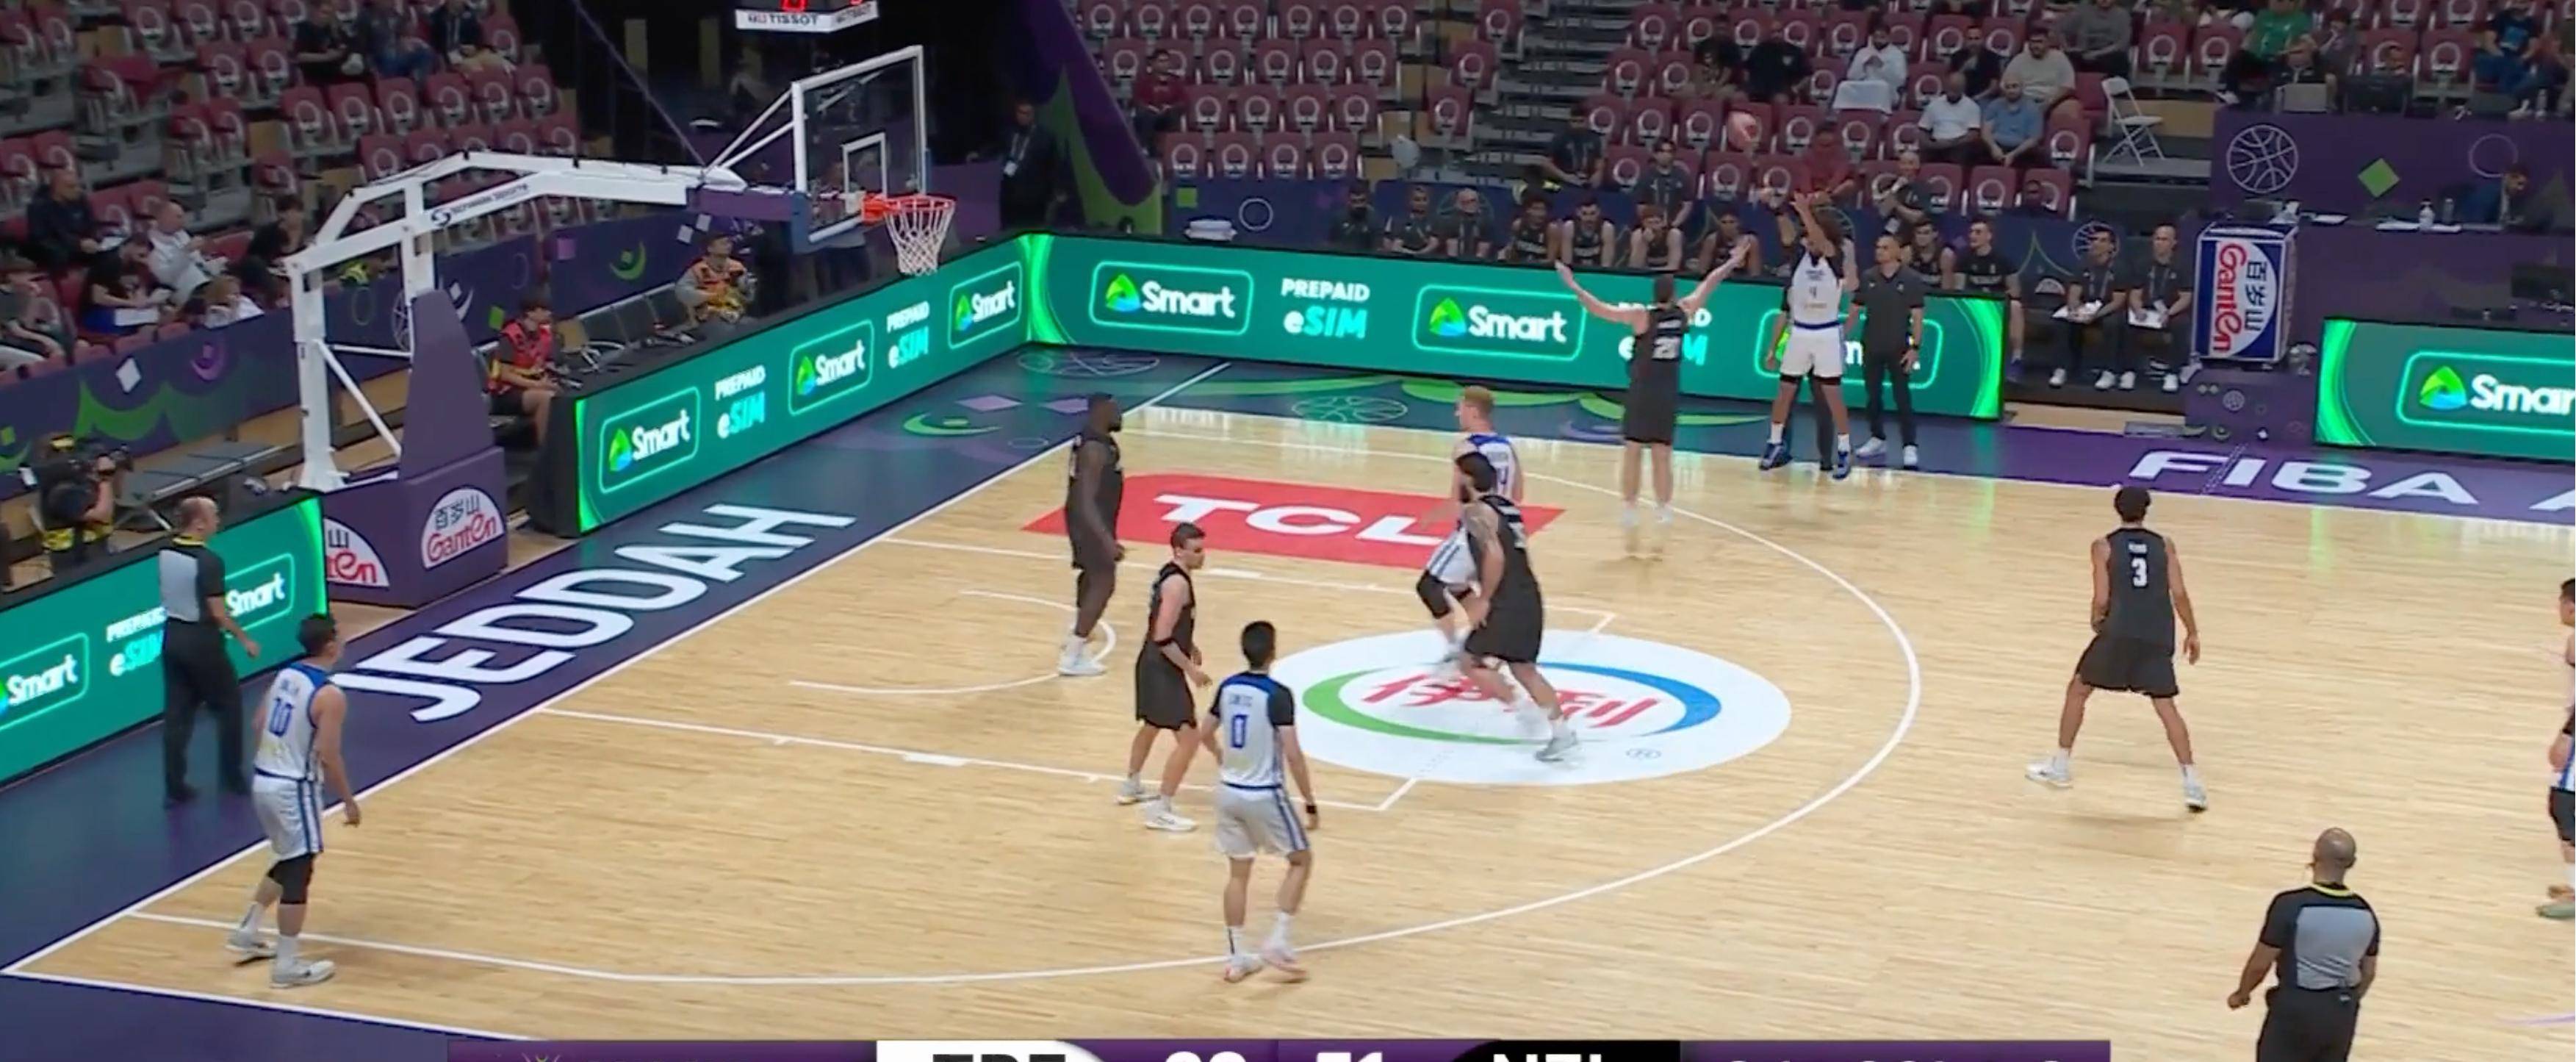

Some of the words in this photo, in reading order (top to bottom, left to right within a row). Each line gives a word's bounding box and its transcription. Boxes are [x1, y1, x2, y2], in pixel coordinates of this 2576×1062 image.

[973, 280, 1015, 322] Smart
[1142, 281, 1235, 317] Smart
[1281, 278, 1370, 302] PREPAID
[1284, 305, 1367, 339] eSIM
[1469, 305, 1566, 342] Smart
[715, 365, 766, 400] PREPAID
[816, 340, 865, 386] Smart
[2470, 373, 2576, 415] Smar
[632, 409, 690, 460] Smart
[717, 392, 765, 439] eSIM
[2129, 451, 2478, 505] FIBA
[1154, 494, 1442, 545] TCL
[2131, 557, 2147, 587] 3
[226, 573, 286, 617] Smart
[329, 504, 857, 723] JEDDAH
[7, 653, 78, 706] Smart
[1231, 714, 1248, 749] 0
